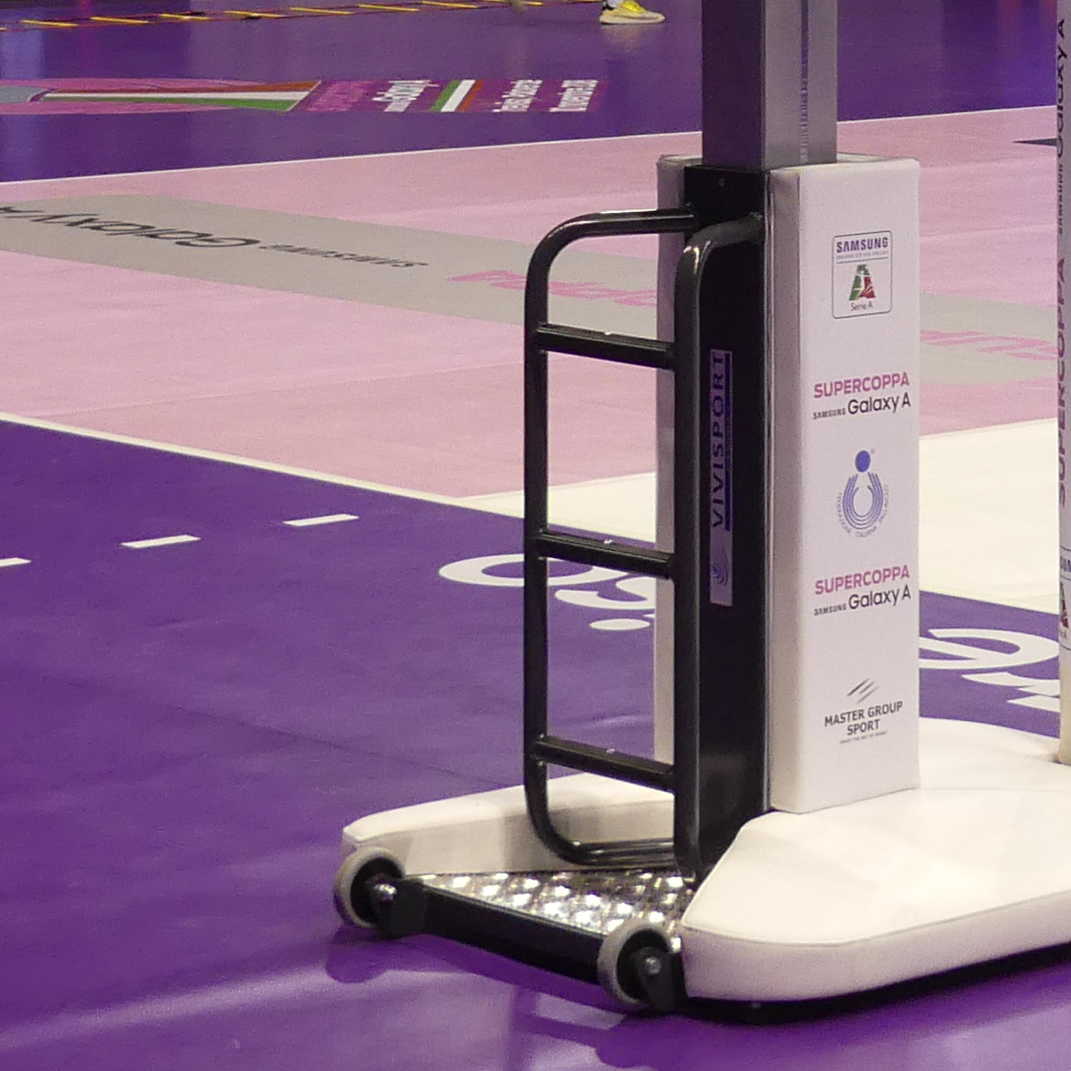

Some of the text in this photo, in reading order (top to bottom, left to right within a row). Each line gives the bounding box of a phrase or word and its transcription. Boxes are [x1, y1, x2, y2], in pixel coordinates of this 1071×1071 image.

[836, 237, 888, 253] SAMSUNG
[851, 302, 873, 311] Serie A
[814, 372, 909, 398] SUPERCOPPA
[813, 392, 911, 419] SAMSUNG Galaxy A
[712, 356, 724, 529] VIVISPORT
[815, 565, 910, 595] SUPERCOPPA
[814, 585, 911, 616] SAMSUNG Galaxy A
[824, 701, 903, 727] MASTER GROUP
[847, 719, 880, 735] SPORT
